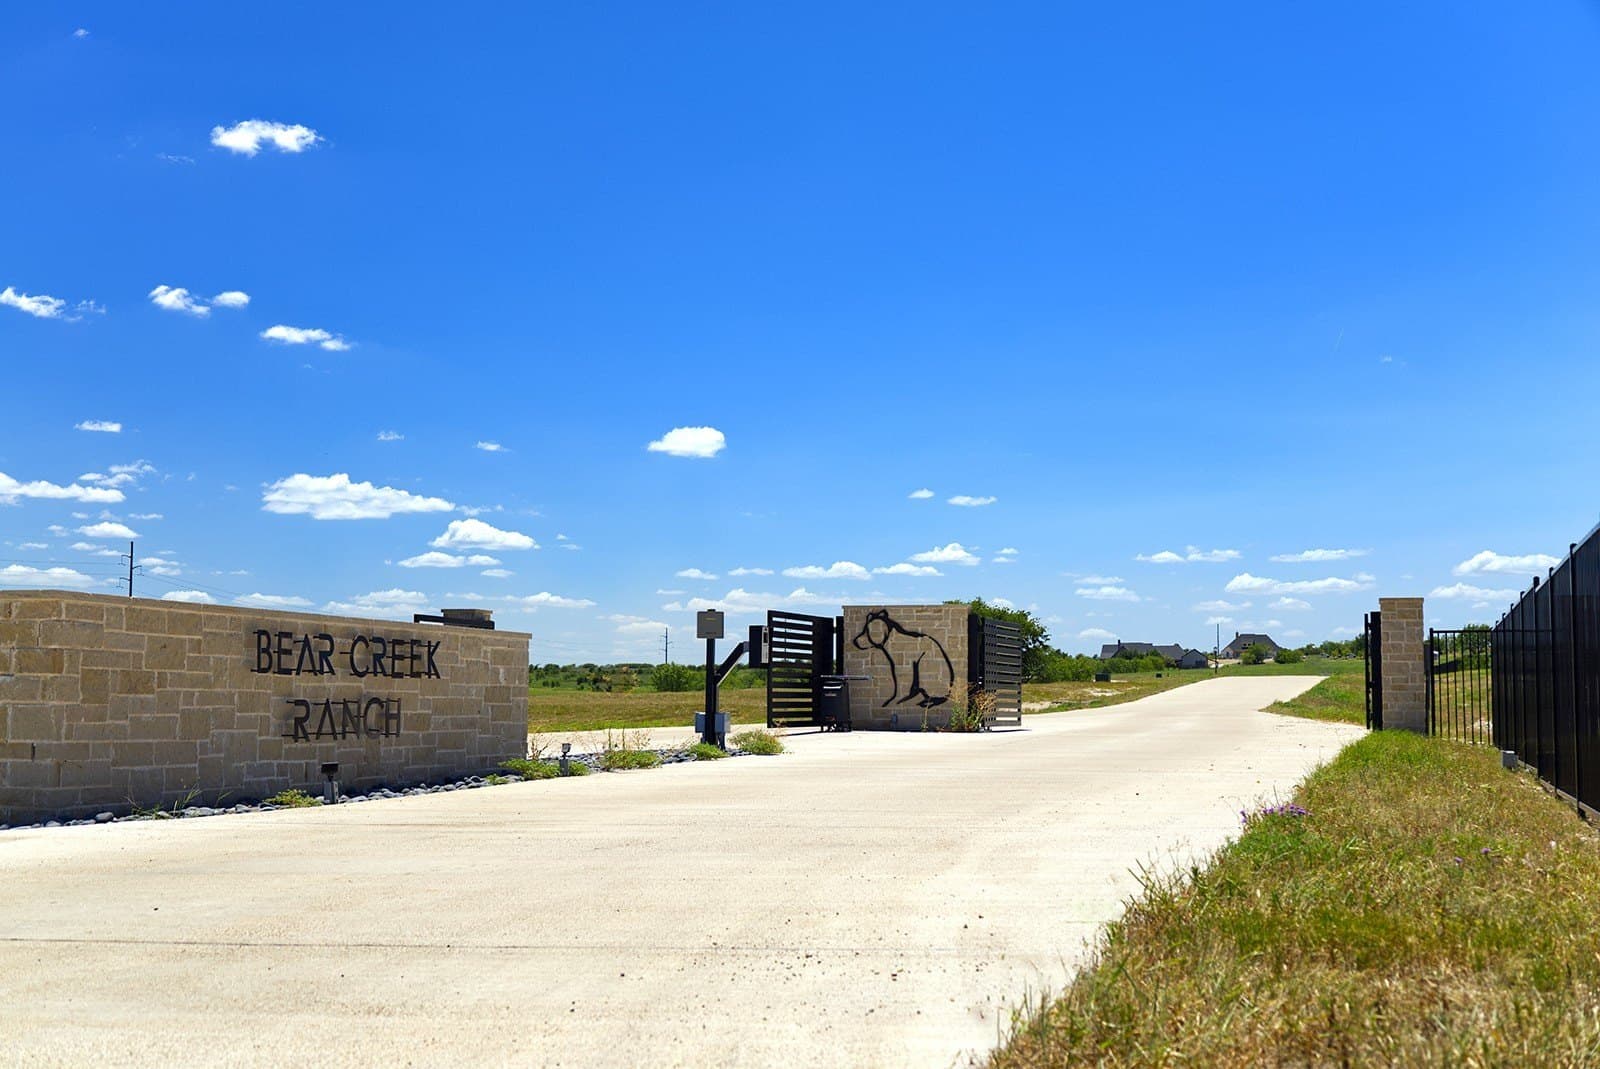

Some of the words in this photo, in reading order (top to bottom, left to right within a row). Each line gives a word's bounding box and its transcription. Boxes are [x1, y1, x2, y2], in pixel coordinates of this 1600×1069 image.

[255, 629, 336, 676] BEAR
[350, 635, 441, 679] CREEK
[293, 697, 401, 742] RANCH
